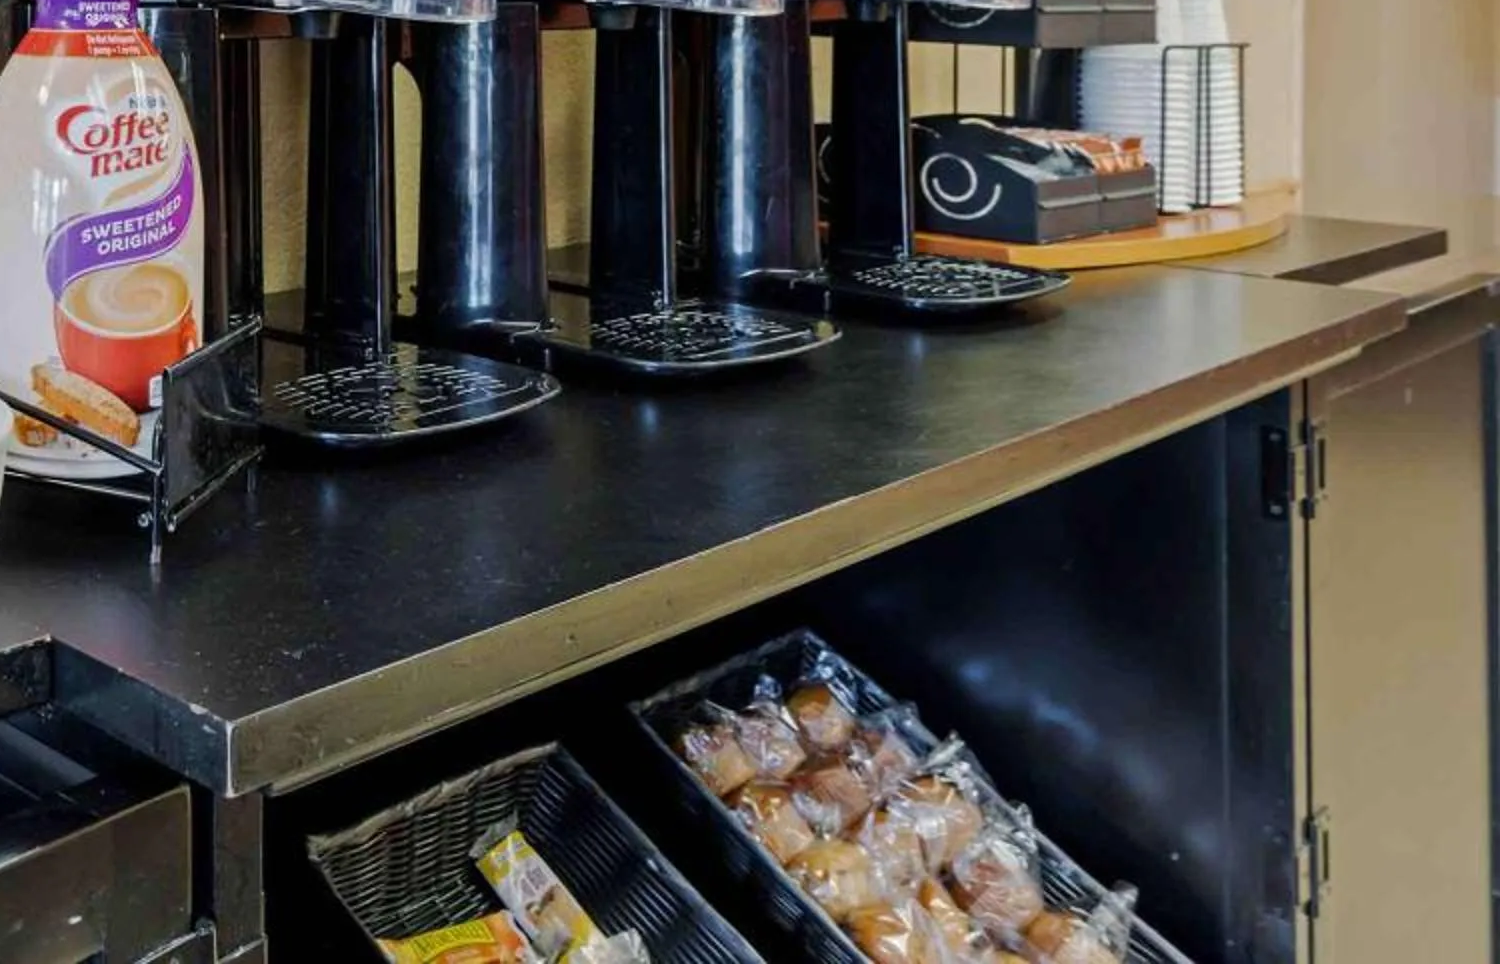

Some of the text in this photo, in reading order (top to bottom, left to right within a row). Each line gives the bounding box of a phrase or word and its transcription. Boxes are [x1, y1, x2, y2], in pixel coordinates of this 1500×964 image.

[57, 104, 169, 155] Coffee
[91, 141, 168, 178] mate
[81, 194, 182, 244] SWEETENED
[97, 220, 177, 255] ORIGINAL
